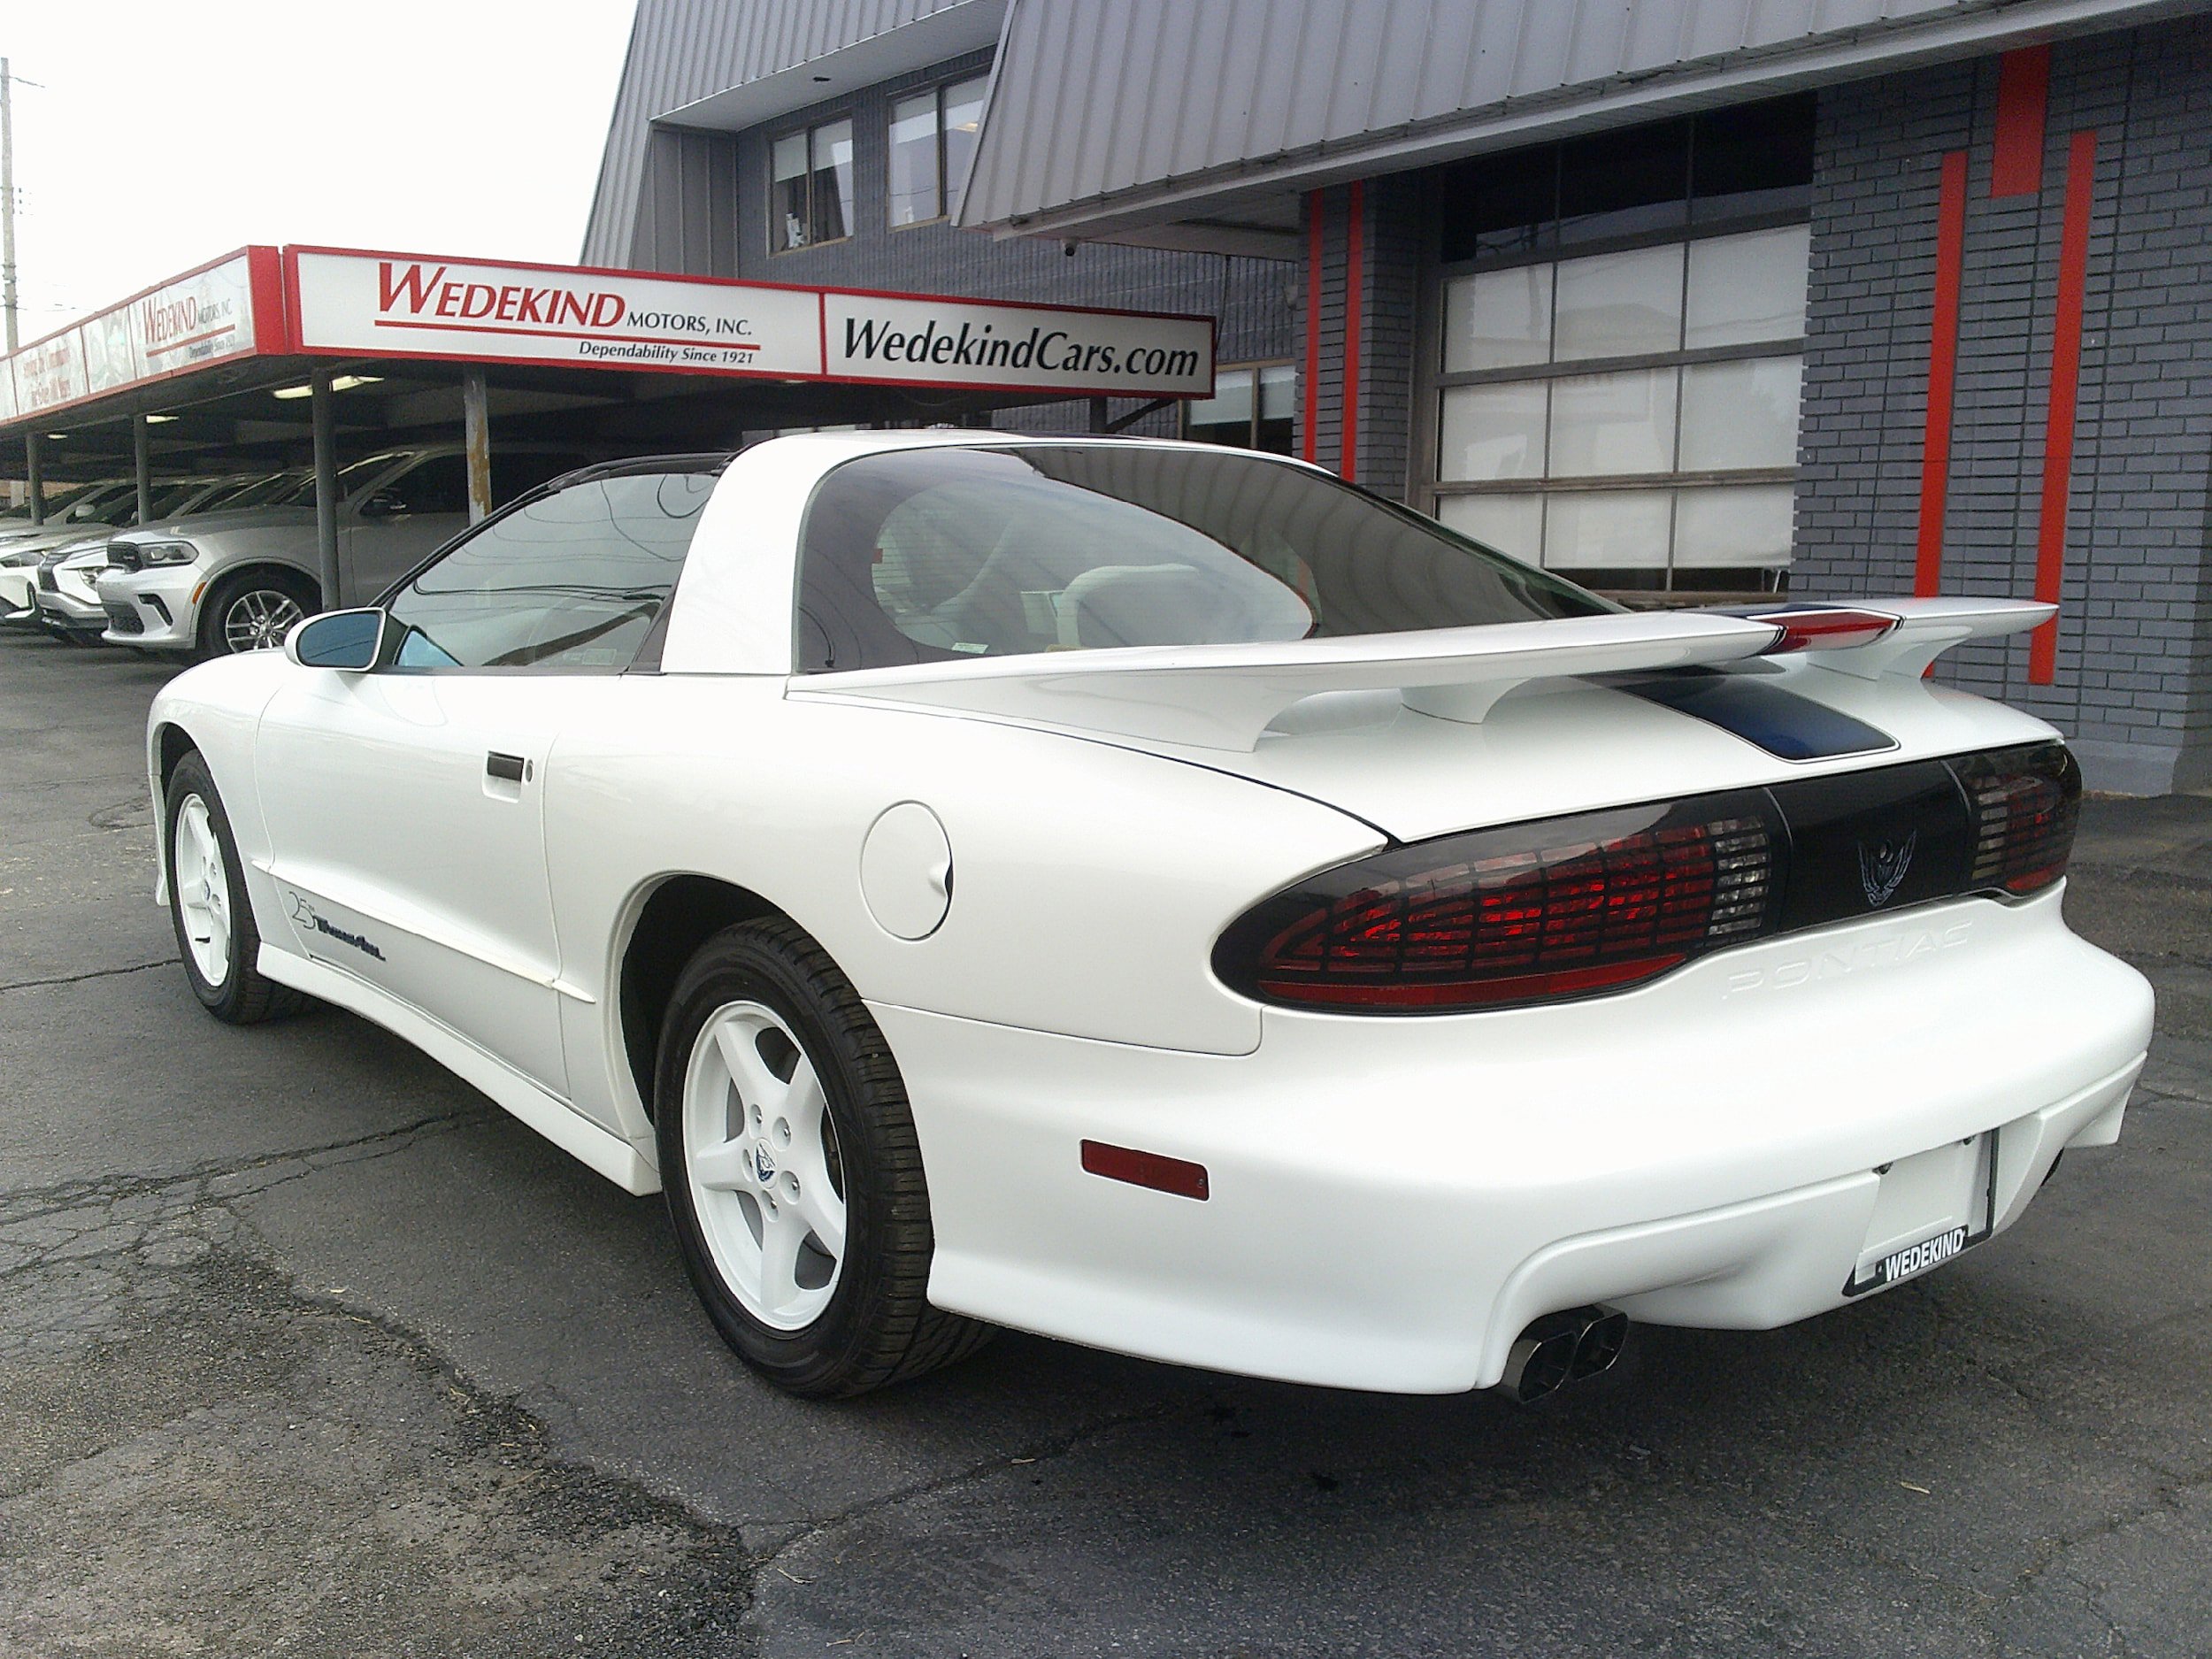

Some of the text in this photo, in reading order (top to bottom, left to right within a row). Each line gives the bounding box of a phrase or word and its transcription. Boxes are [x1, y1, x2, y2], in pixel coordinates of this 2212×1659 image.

[142, 296, 196, 345] WEDEKIND
[378, 261, 752, 335] WEDEKIND MOTORS, INC.
[579, 341, 754, 364] Dependability Since 1921
[844, 317, 1200, 377] WedekindCars.com
[1722, 919, 1973, 1000] PONTIAC
[1885, 1227, 1966, 1282] WEDEKIND
